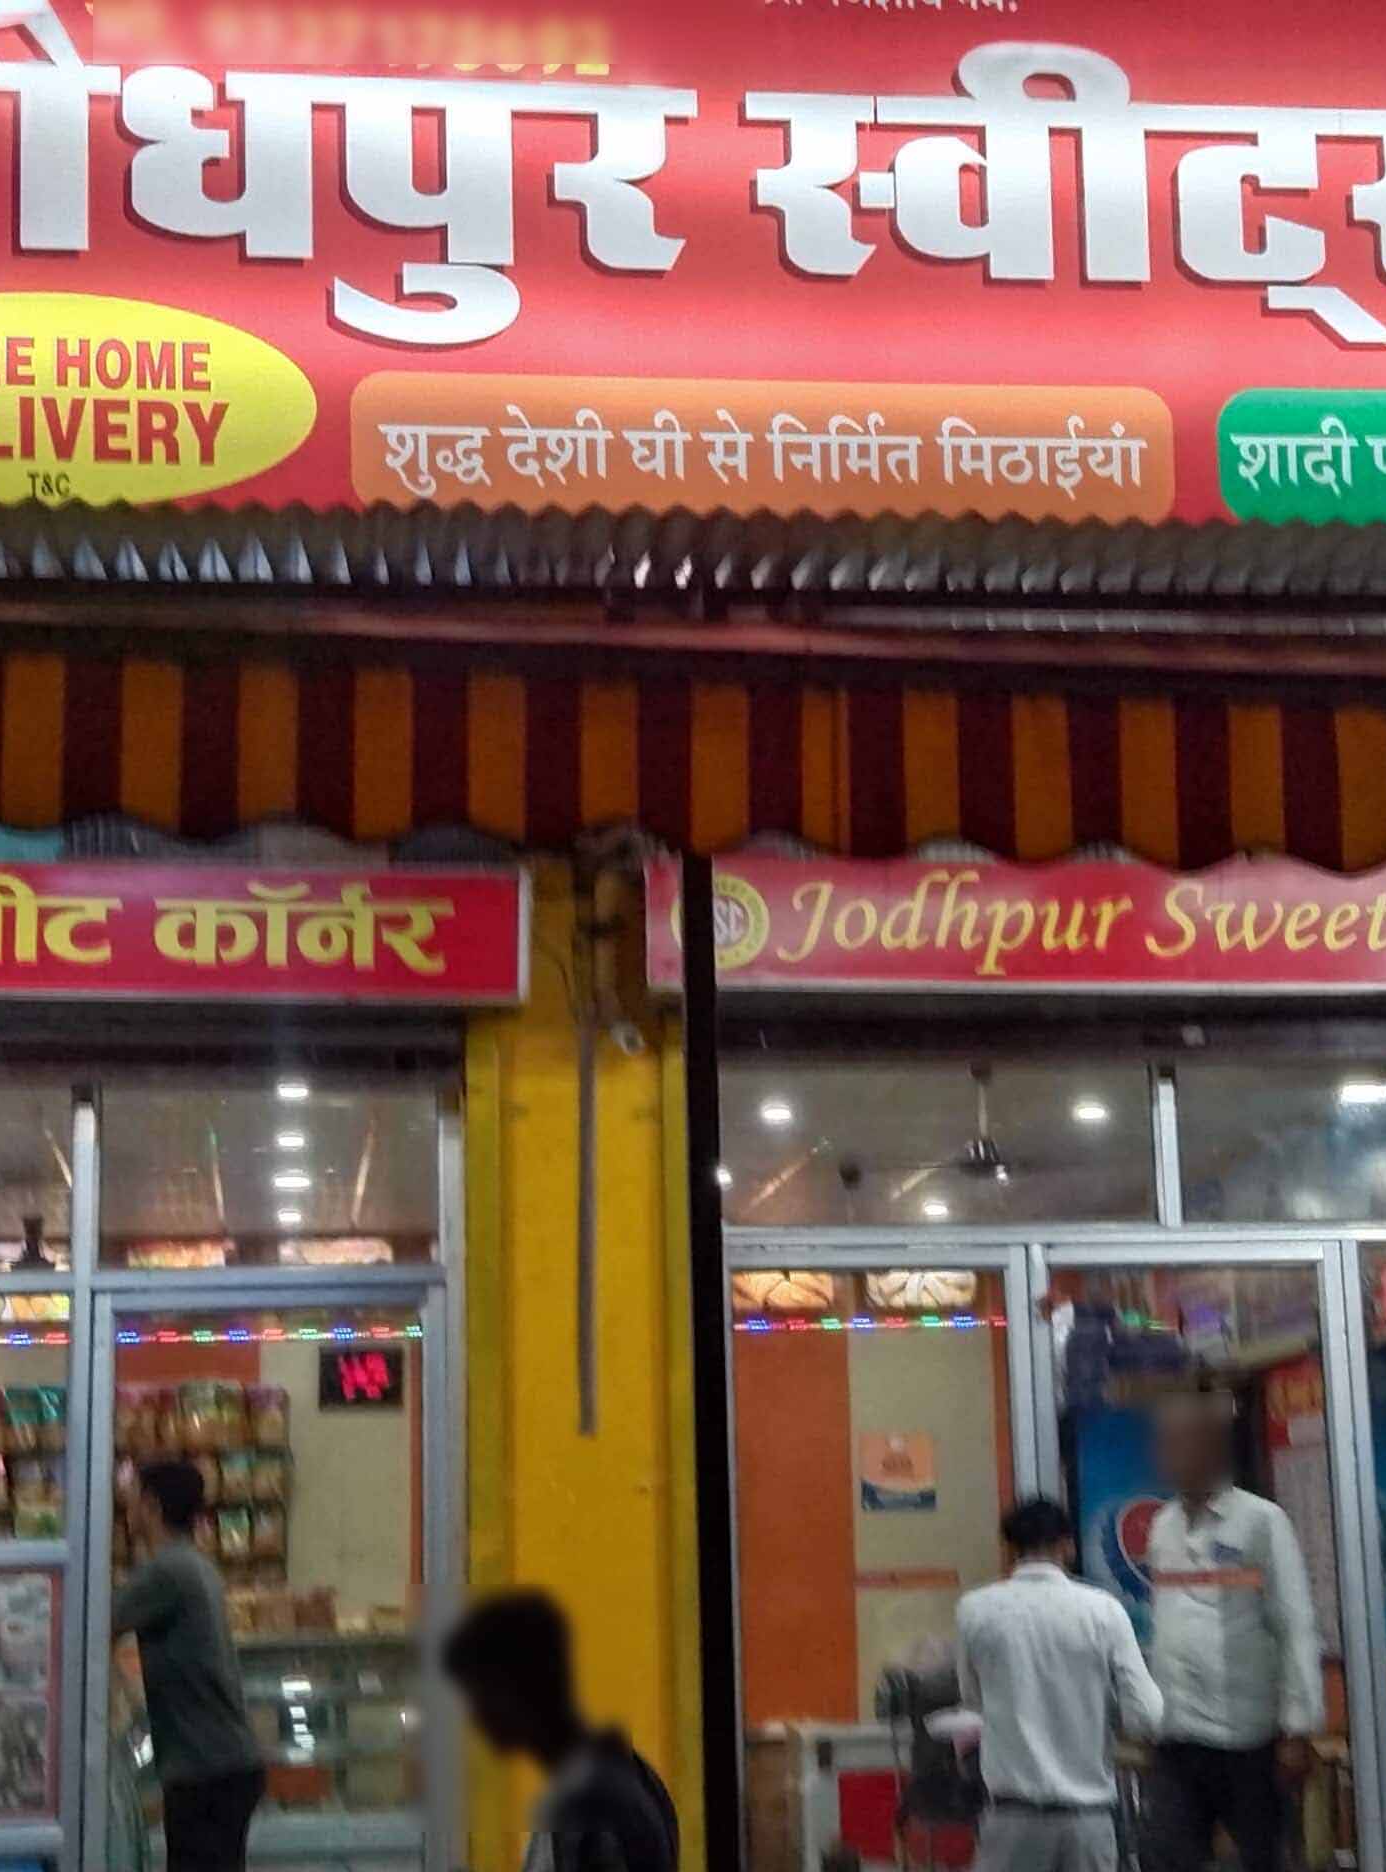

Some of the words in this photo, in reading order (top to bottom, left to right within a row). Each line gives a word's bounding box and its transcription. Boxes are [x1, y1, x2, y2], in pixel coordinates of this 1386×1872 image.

[56, 337, 212, 393] HOME
[27, 470, 71, 498] T&C
[378, 420, 492, 498] शुद्ध
[500, 403, 613, 486] देशी
[622, 409, 691, 482] घी
[701, 409, 752, 484] से
[767, 410, 923, 487] निर्मित
[937, 412, 1148, 500] मिठाईयां
[1229, 414, 1358, 496] शादी
[153, 880, 455, 976] कॉर्नर
[777, 869, 1135, 975] Jodhpur
